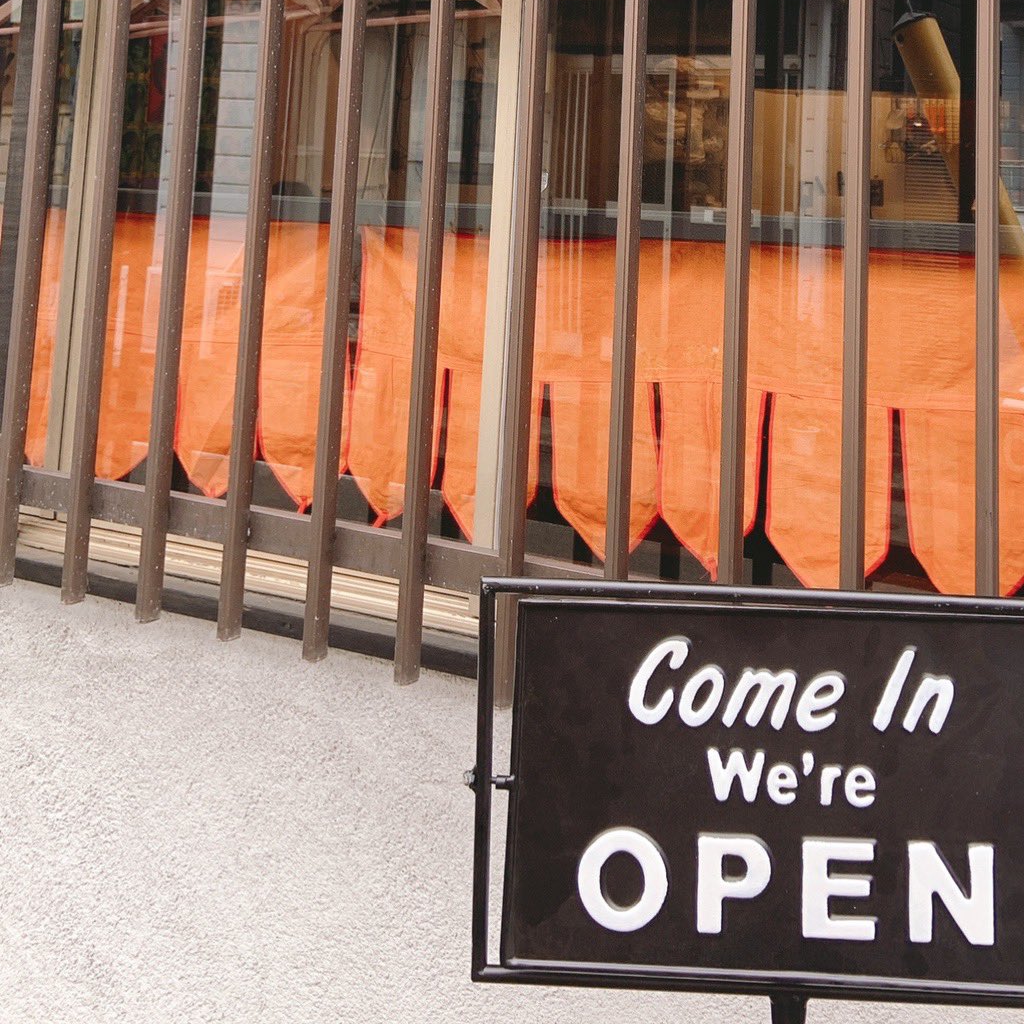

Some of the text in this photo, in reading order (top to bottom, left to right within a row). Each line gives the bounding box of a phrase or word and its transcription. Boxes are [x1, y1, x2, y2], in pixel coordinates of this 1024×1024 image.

[628, 636, 955, 734] Come In
[707, 746, 877, 808] We're
[577, 827, 996, 946] OPEN
